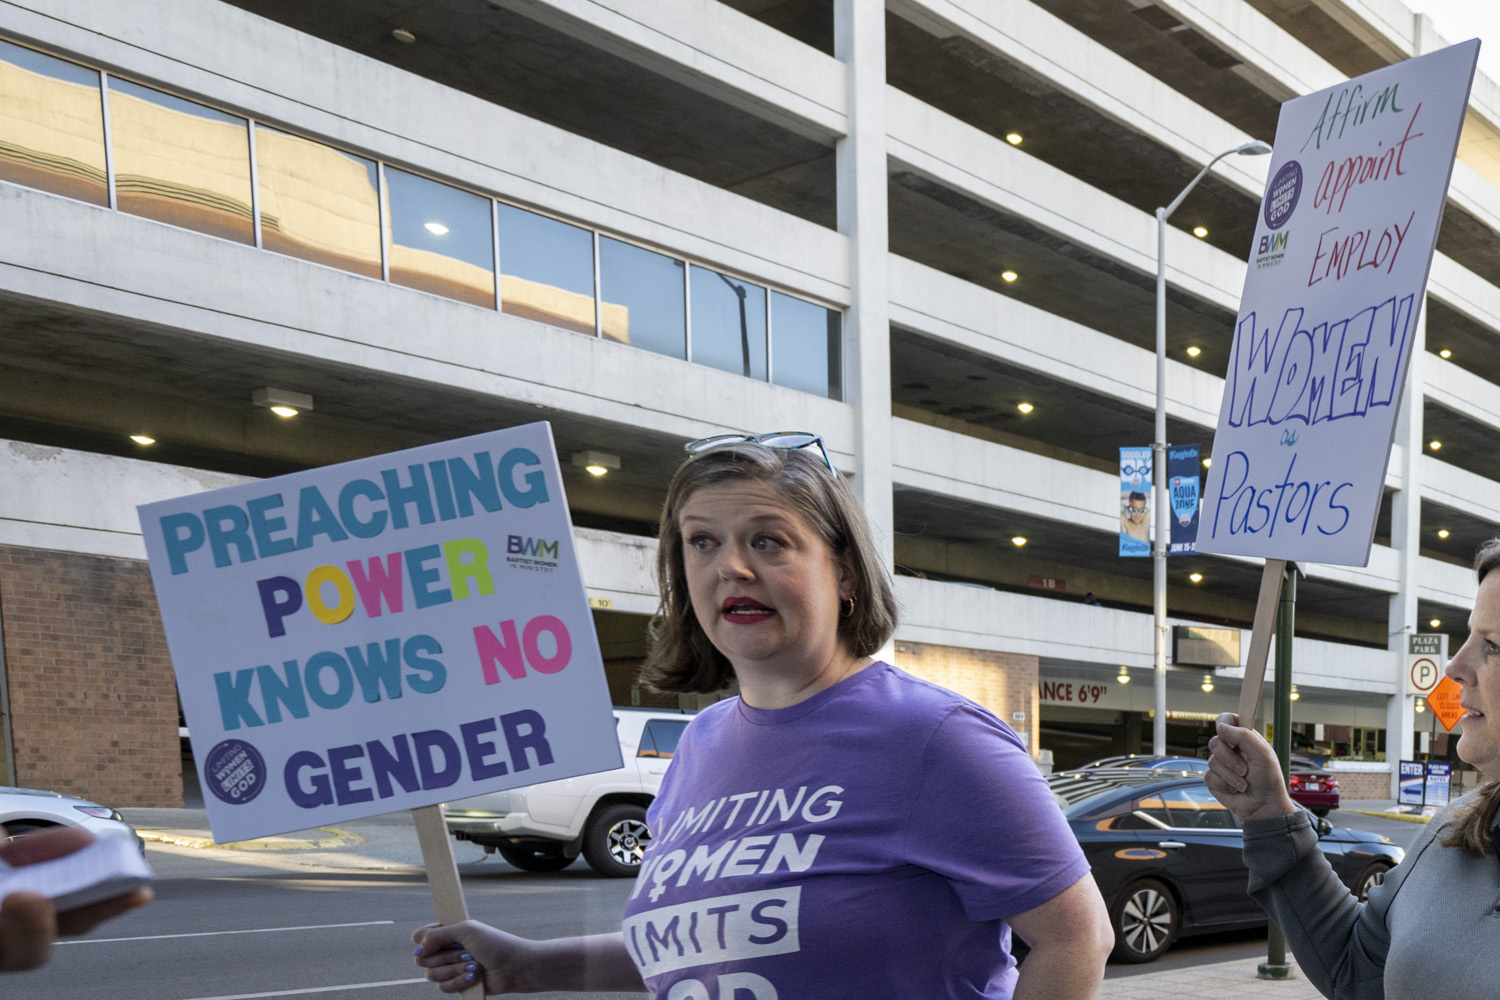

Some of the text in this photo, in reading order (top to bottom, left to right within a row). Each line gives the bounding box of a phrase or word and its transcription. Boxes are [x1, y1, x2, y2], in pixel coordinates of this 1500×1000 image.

[1300, 82, 1404, 154] Affirm
[1313, 102, 1425, 215] appoint
[1272, 176, 1298, 199] WOMEN
[1270, 201, 1291, 222] GOD
[1258, 230, 1290, 255] BWM
[1308, 210, 1416, 288] EMPLOY
[1279, 427, 1300, 448] as
[1173, 485, 1197, 499] AQUA
[1175, 498, 1195, 510] ZONE
[1211, 450, 1354, 540] Pastors
[159, 447, 550, 575] PREACHING
[506, 534, 559, 559] BWM
[533, 559, 558, 568] WOMEN
[257, 537, 495, 638] POWER
[1412, 637, 1438, 645] PLAZA
[1414, 645, 1436, 653] PARK
[213, 614, 573, 731] KNOWS NO
[1420, 666, 1430, 683] P
[215, 750, 248, 780] WOMEN
[283, 709, 554, 809] GENDER
[1400, 762, 1423, 776] ENTER
[230, 772, 256, 798] GOD
[630, 898, 788, 967] IMITS
